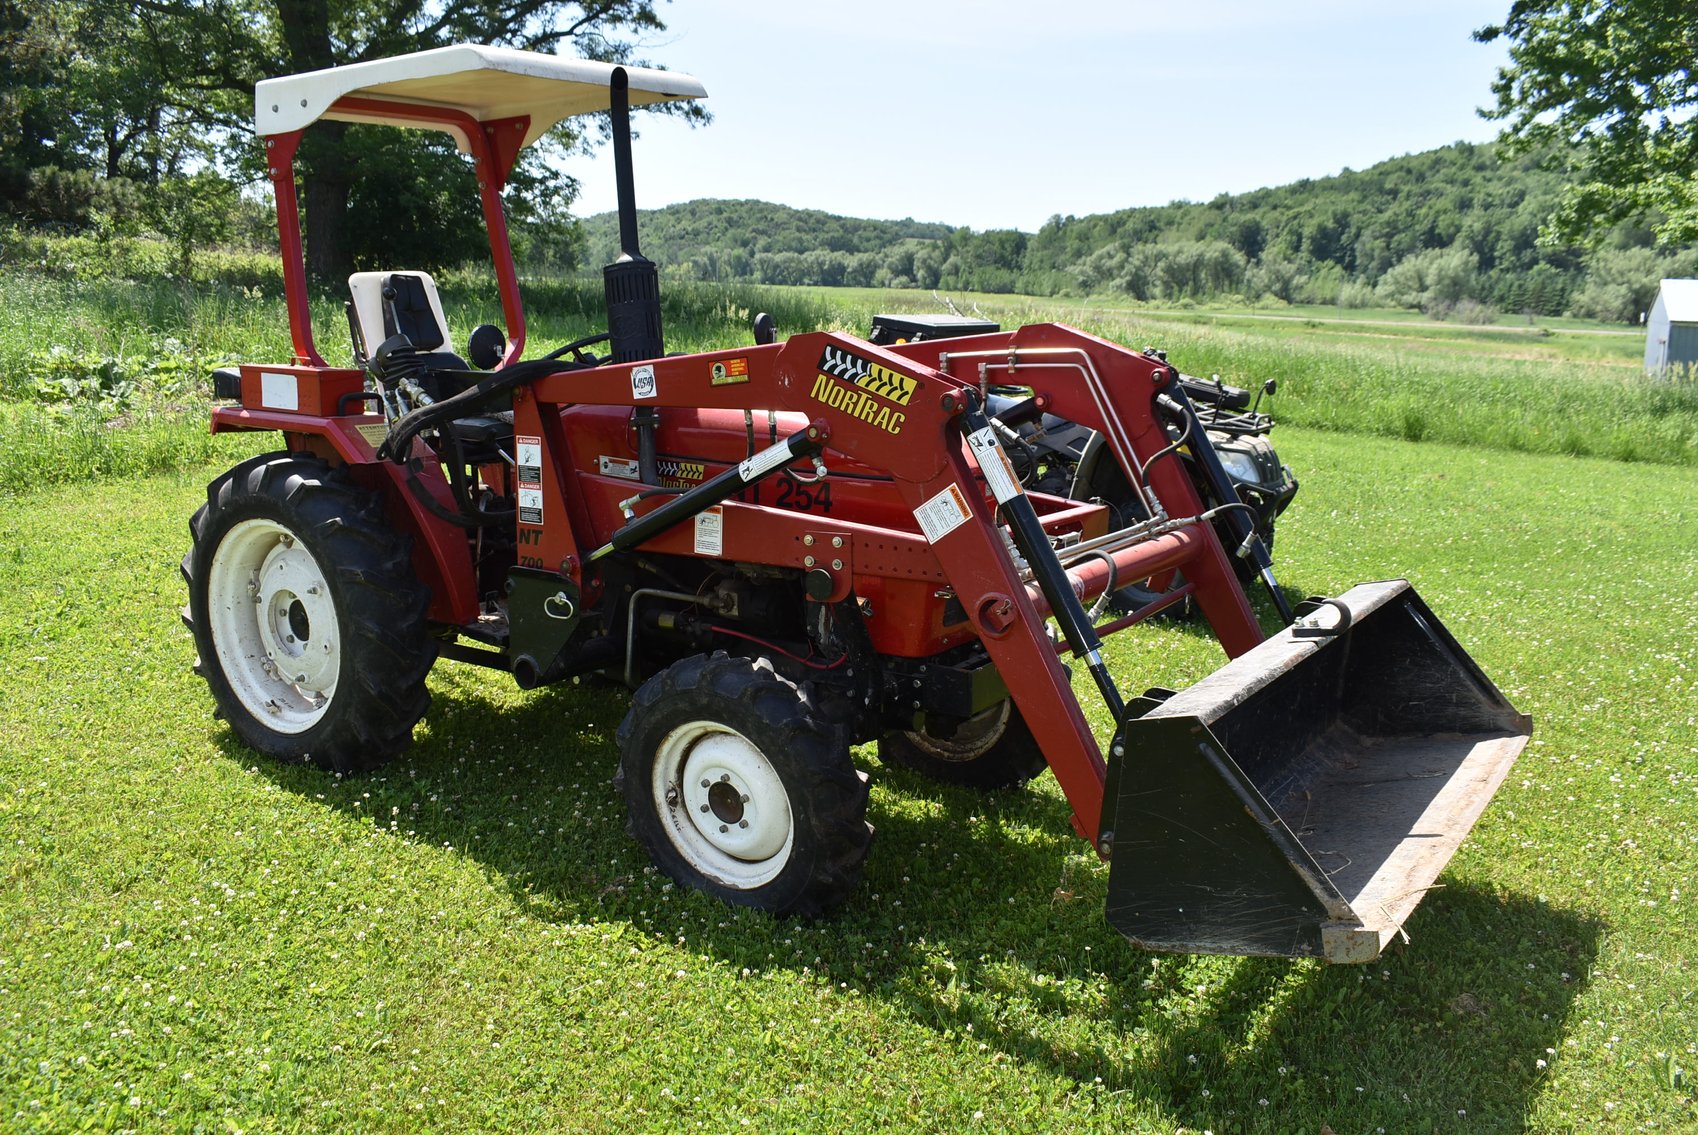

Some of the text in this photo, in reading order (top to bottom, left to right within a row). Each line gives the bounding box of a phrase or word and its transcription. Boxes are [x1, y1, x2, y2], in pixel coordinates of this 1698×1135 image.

[776, 477, 833, 513] 254
[519, 528, 544, 546] NT
[520, 555, 544, 569] 700
